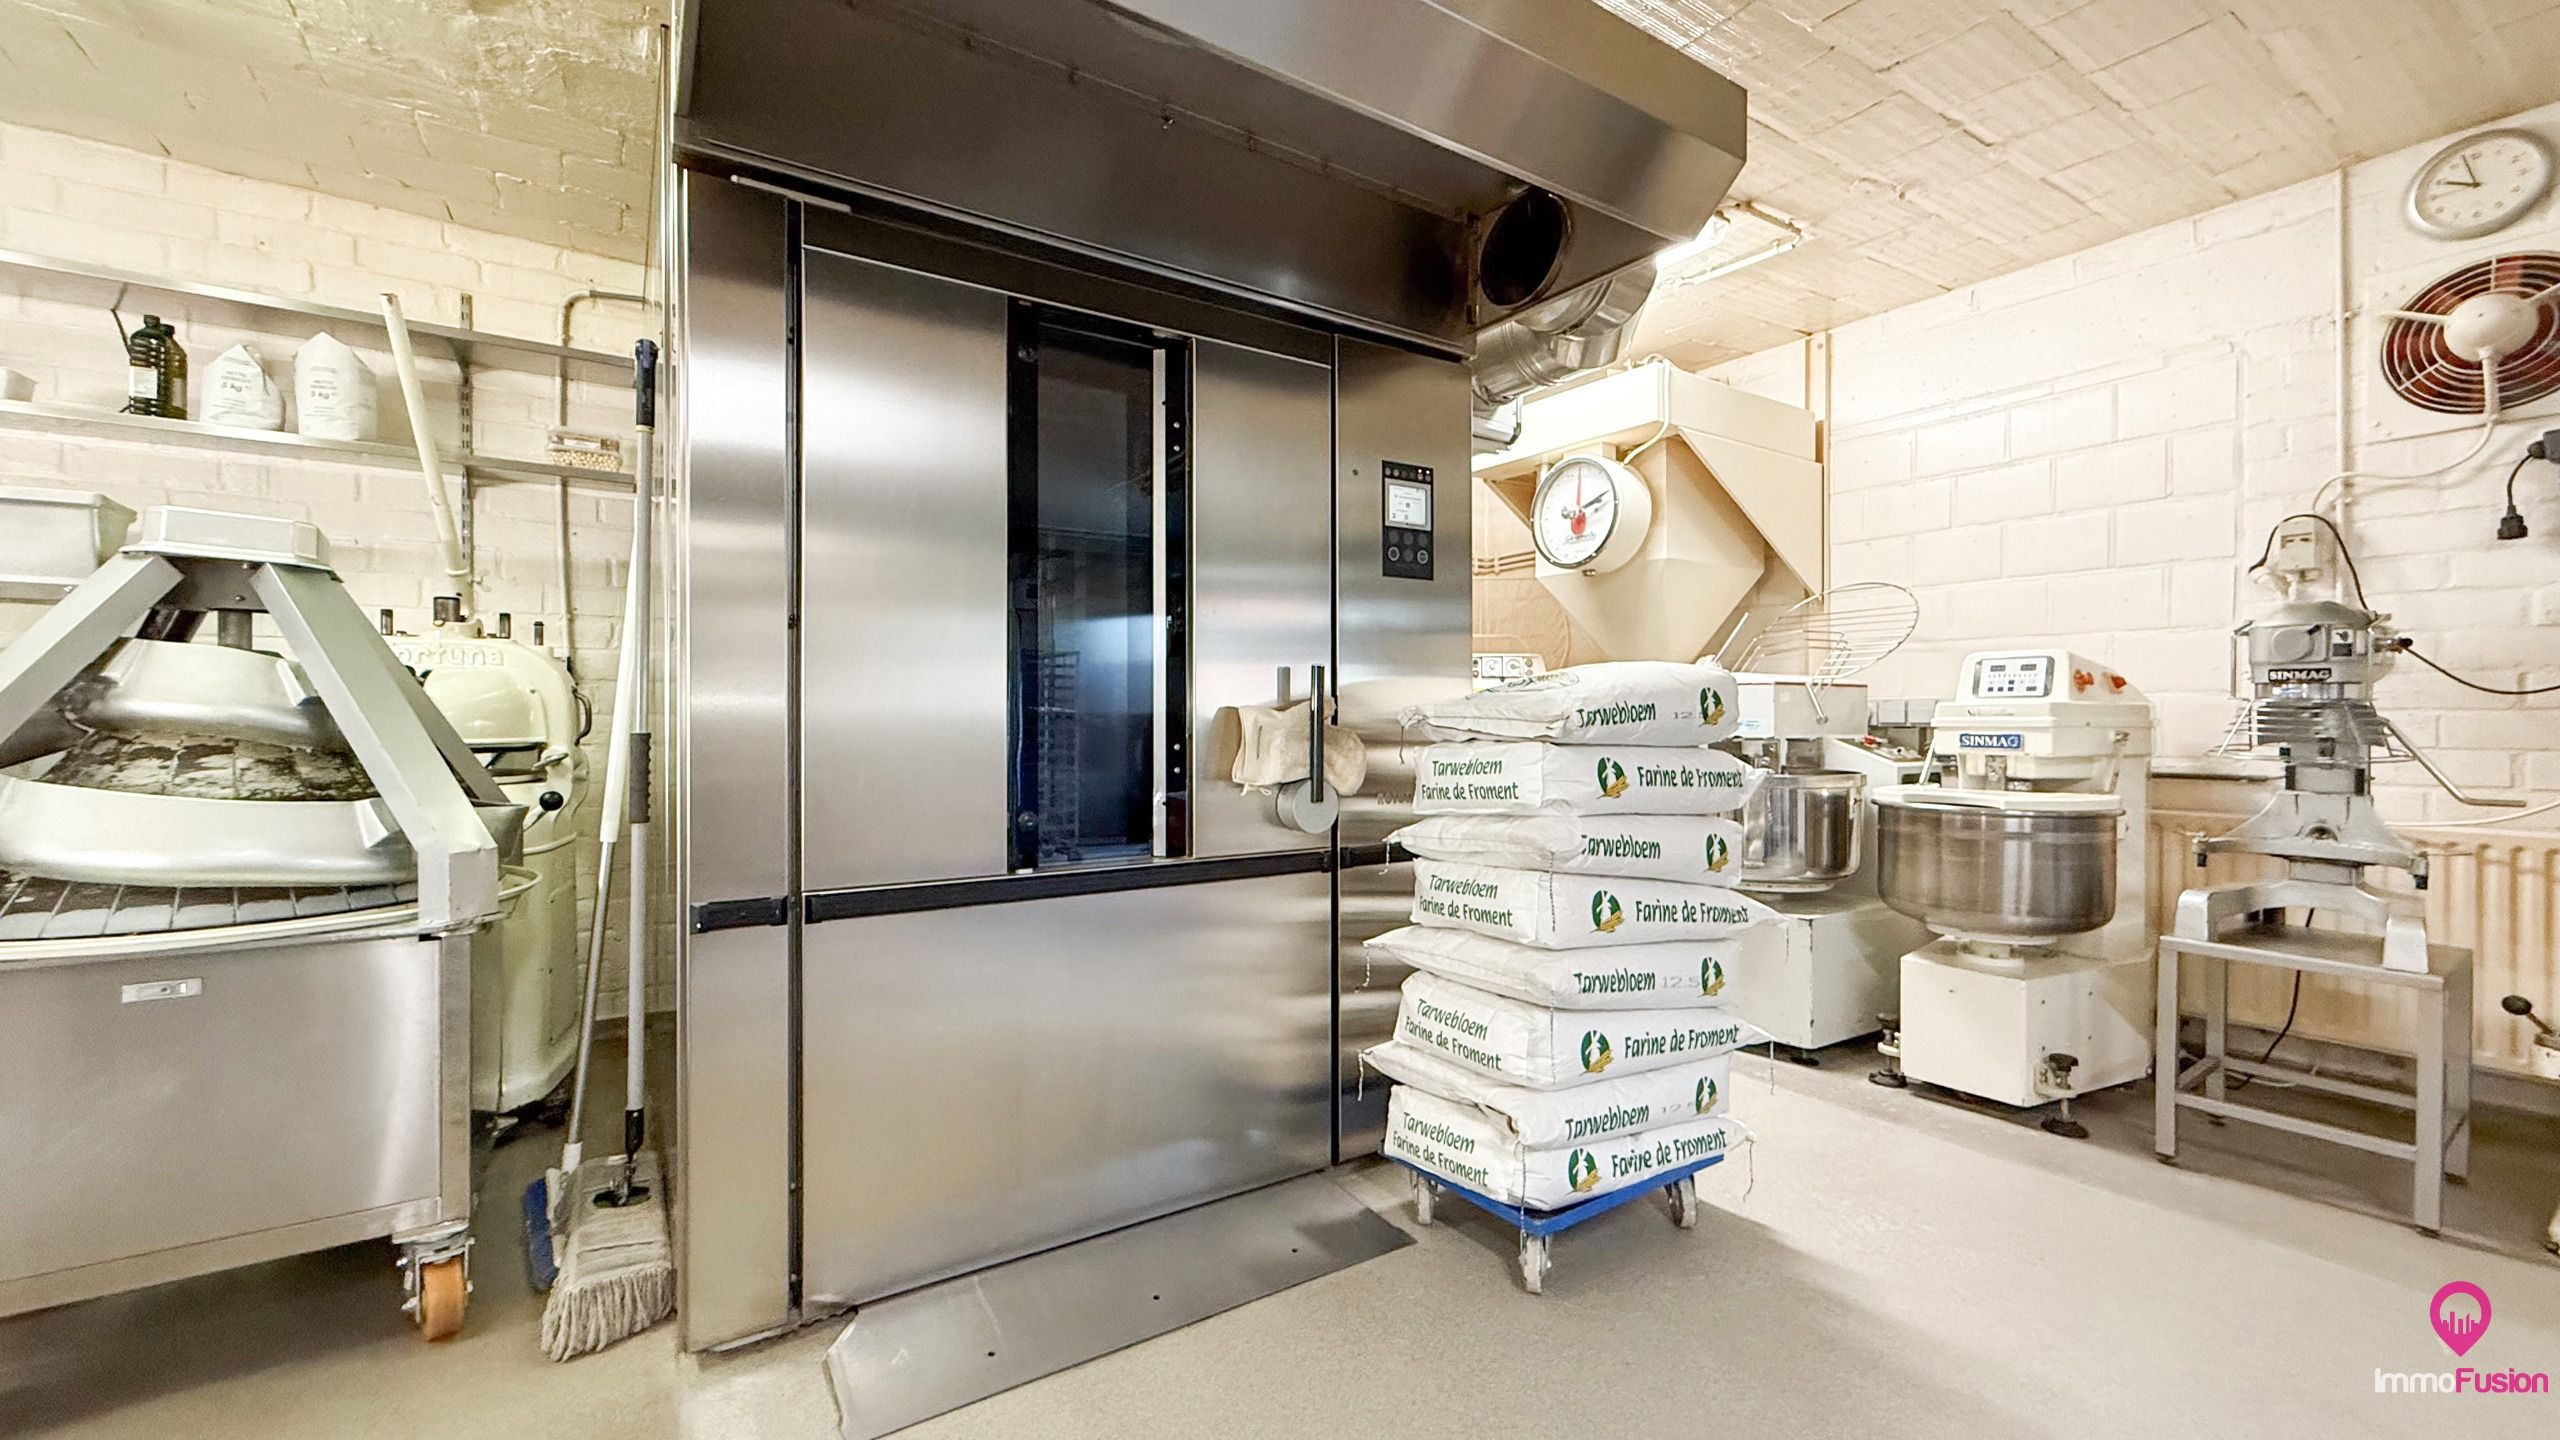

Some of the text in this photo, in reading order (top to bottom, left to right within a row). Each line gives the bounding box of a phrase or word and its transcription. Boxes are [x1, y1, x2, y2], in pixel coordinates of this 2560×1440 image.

[2269, 669, 2330, 681] SINMAG
[1576, 701, 1656, 728] Tarwebloem
[1961, 735, 2019, 748] SINMAG
[1432, 758, 1503, 776] Tarwebloem
[1637, 764, 1744, 789] Farine de Froment
[1421, 782, 1520, 801] Farine de Froment
[1429, 874, 1499, 900] Tarwebloem
[1419, 894, 1513, 926] Farine de Froment
[1636, 899, 1750, 925] Farine de Froment
[1573, 968, 1656, 994] Tarwebloem
[1416, 998, 1488, 1041] Tarwebloem
[1405, 1016, 1503, 1072] Farine de Froment
[1624, 1024, 1740, 1059] Farine de Froment
[1402, 1111, 1475, 1154] Tarwebloem
[1565, 1104, 1650, 1141] Tarwebloem
[1393, 1130, 1490, 1187] Farine de Froment
[1656, 1141, 1672, 1167] de
[1673, 1128, 1727, 1161] Froment
